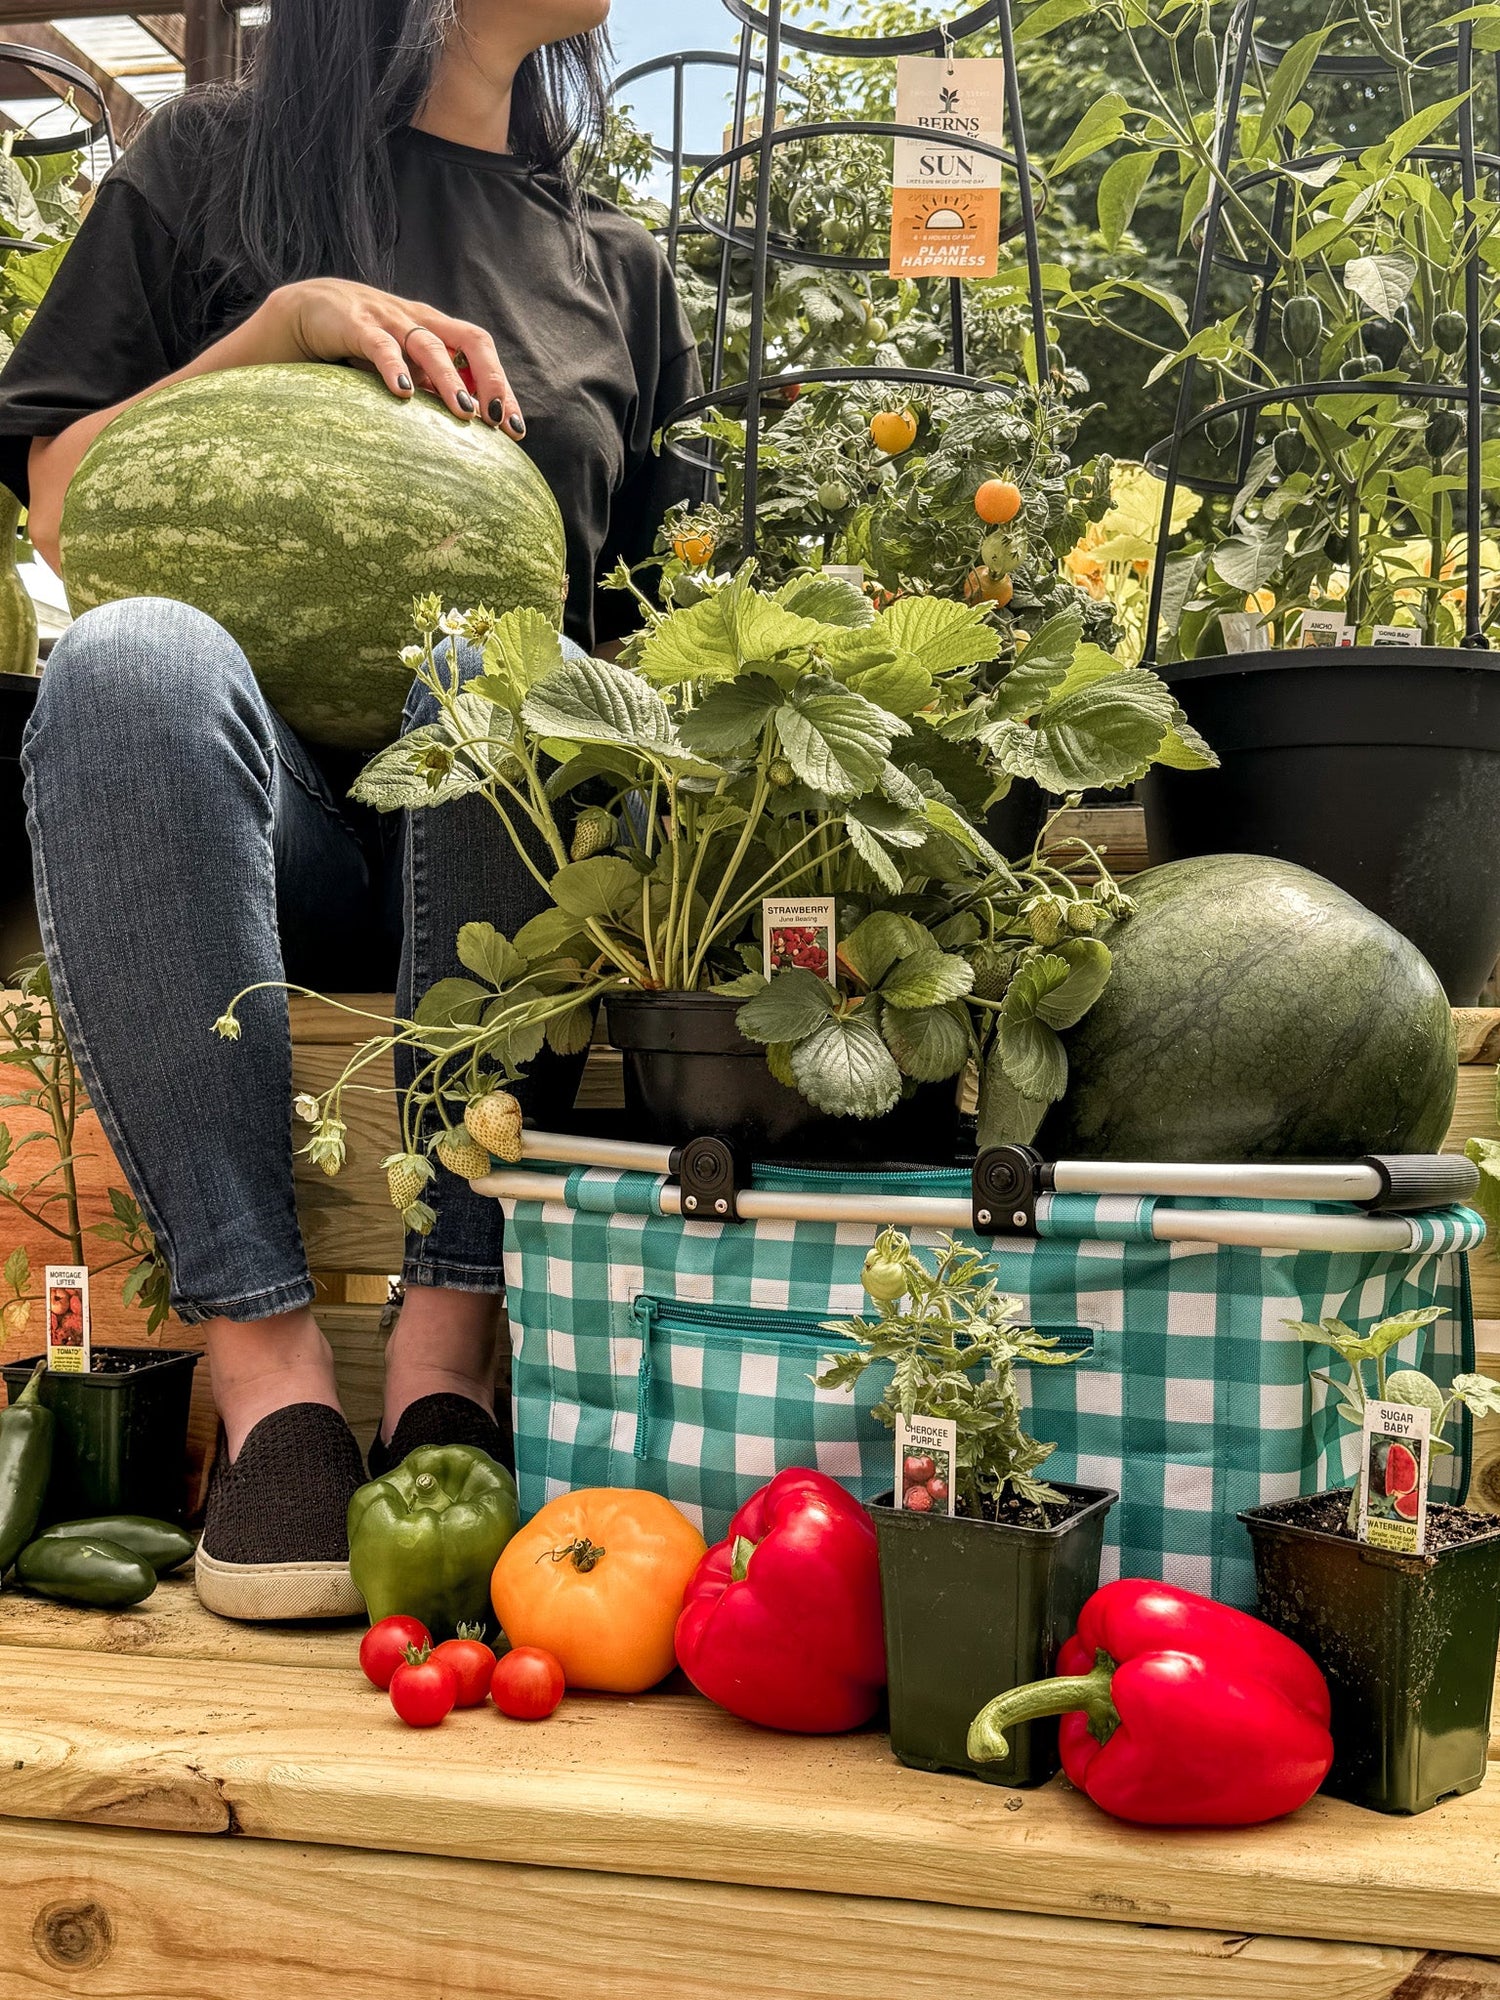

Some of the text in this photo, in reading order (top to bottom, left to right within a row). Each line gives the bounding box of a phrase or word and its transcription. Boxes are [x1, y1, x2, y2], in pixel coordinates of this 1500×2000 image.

[917, 116, 980, 132] BERNS
[919, 154, 975, 177] SUN
[918, 245, 970, 257] PLANT
[901, 256, 986, 267] HAPPINESS
[1310, 622, 1333, 630] ANCHO
[767, 905, 829, 915] STRAWBERRY
[795, 915, 818, 923] Bearing
[50, 1271, 82, 1279] MORTGAGE
[1380, 1409, 1414, 1424] SUGAR
[904, 1424, 949, 1438] CHEROKEE
[1384, 1421, 1410, 1434] BABY
[910, 1434, 942, 1447] PURPLE
[1367, 1519, 1417, 1536] WATERMELON
